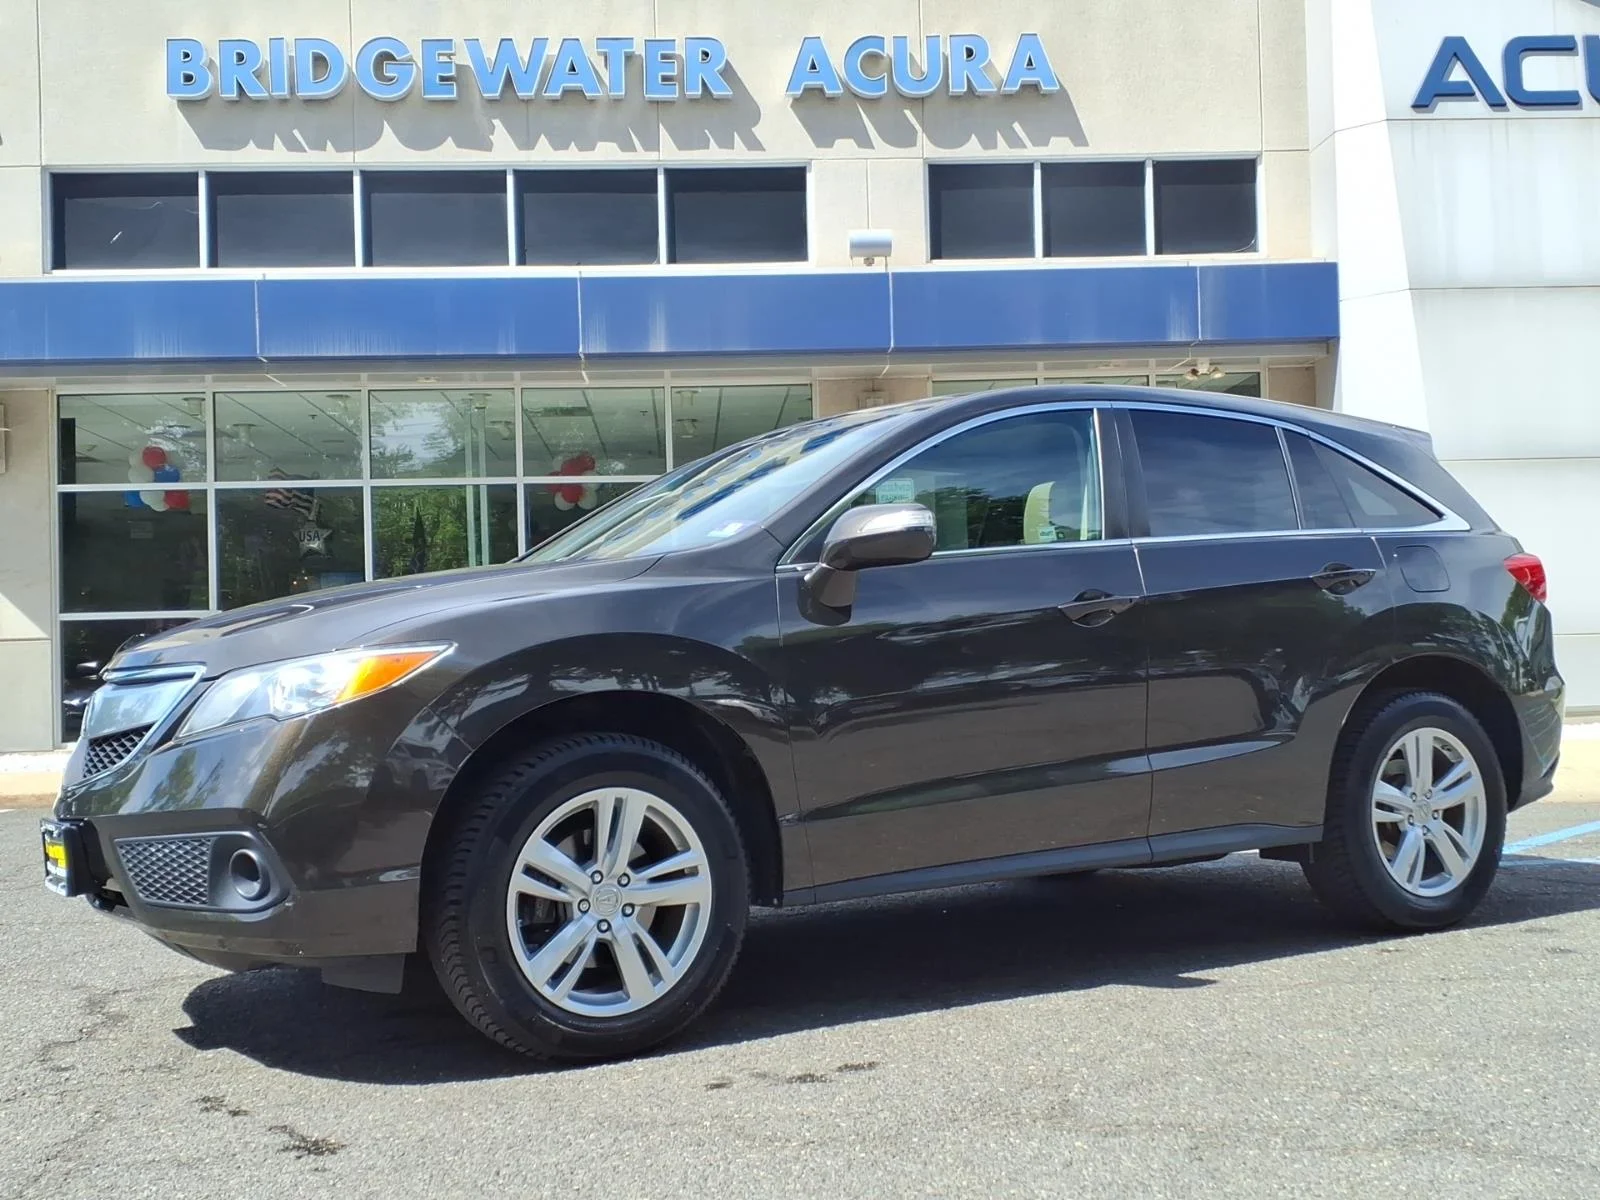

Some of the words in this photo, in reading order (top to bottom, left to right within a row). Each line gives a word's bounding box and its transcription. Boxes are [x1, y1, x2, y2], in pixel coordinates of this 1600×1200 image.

[166, 36, 733, 102] BRIDGEWATER
[785, 33, 1060, 99] ACURA
[1411, 34, 1600, 108] AC
[299, 530, 321, 542] USA
